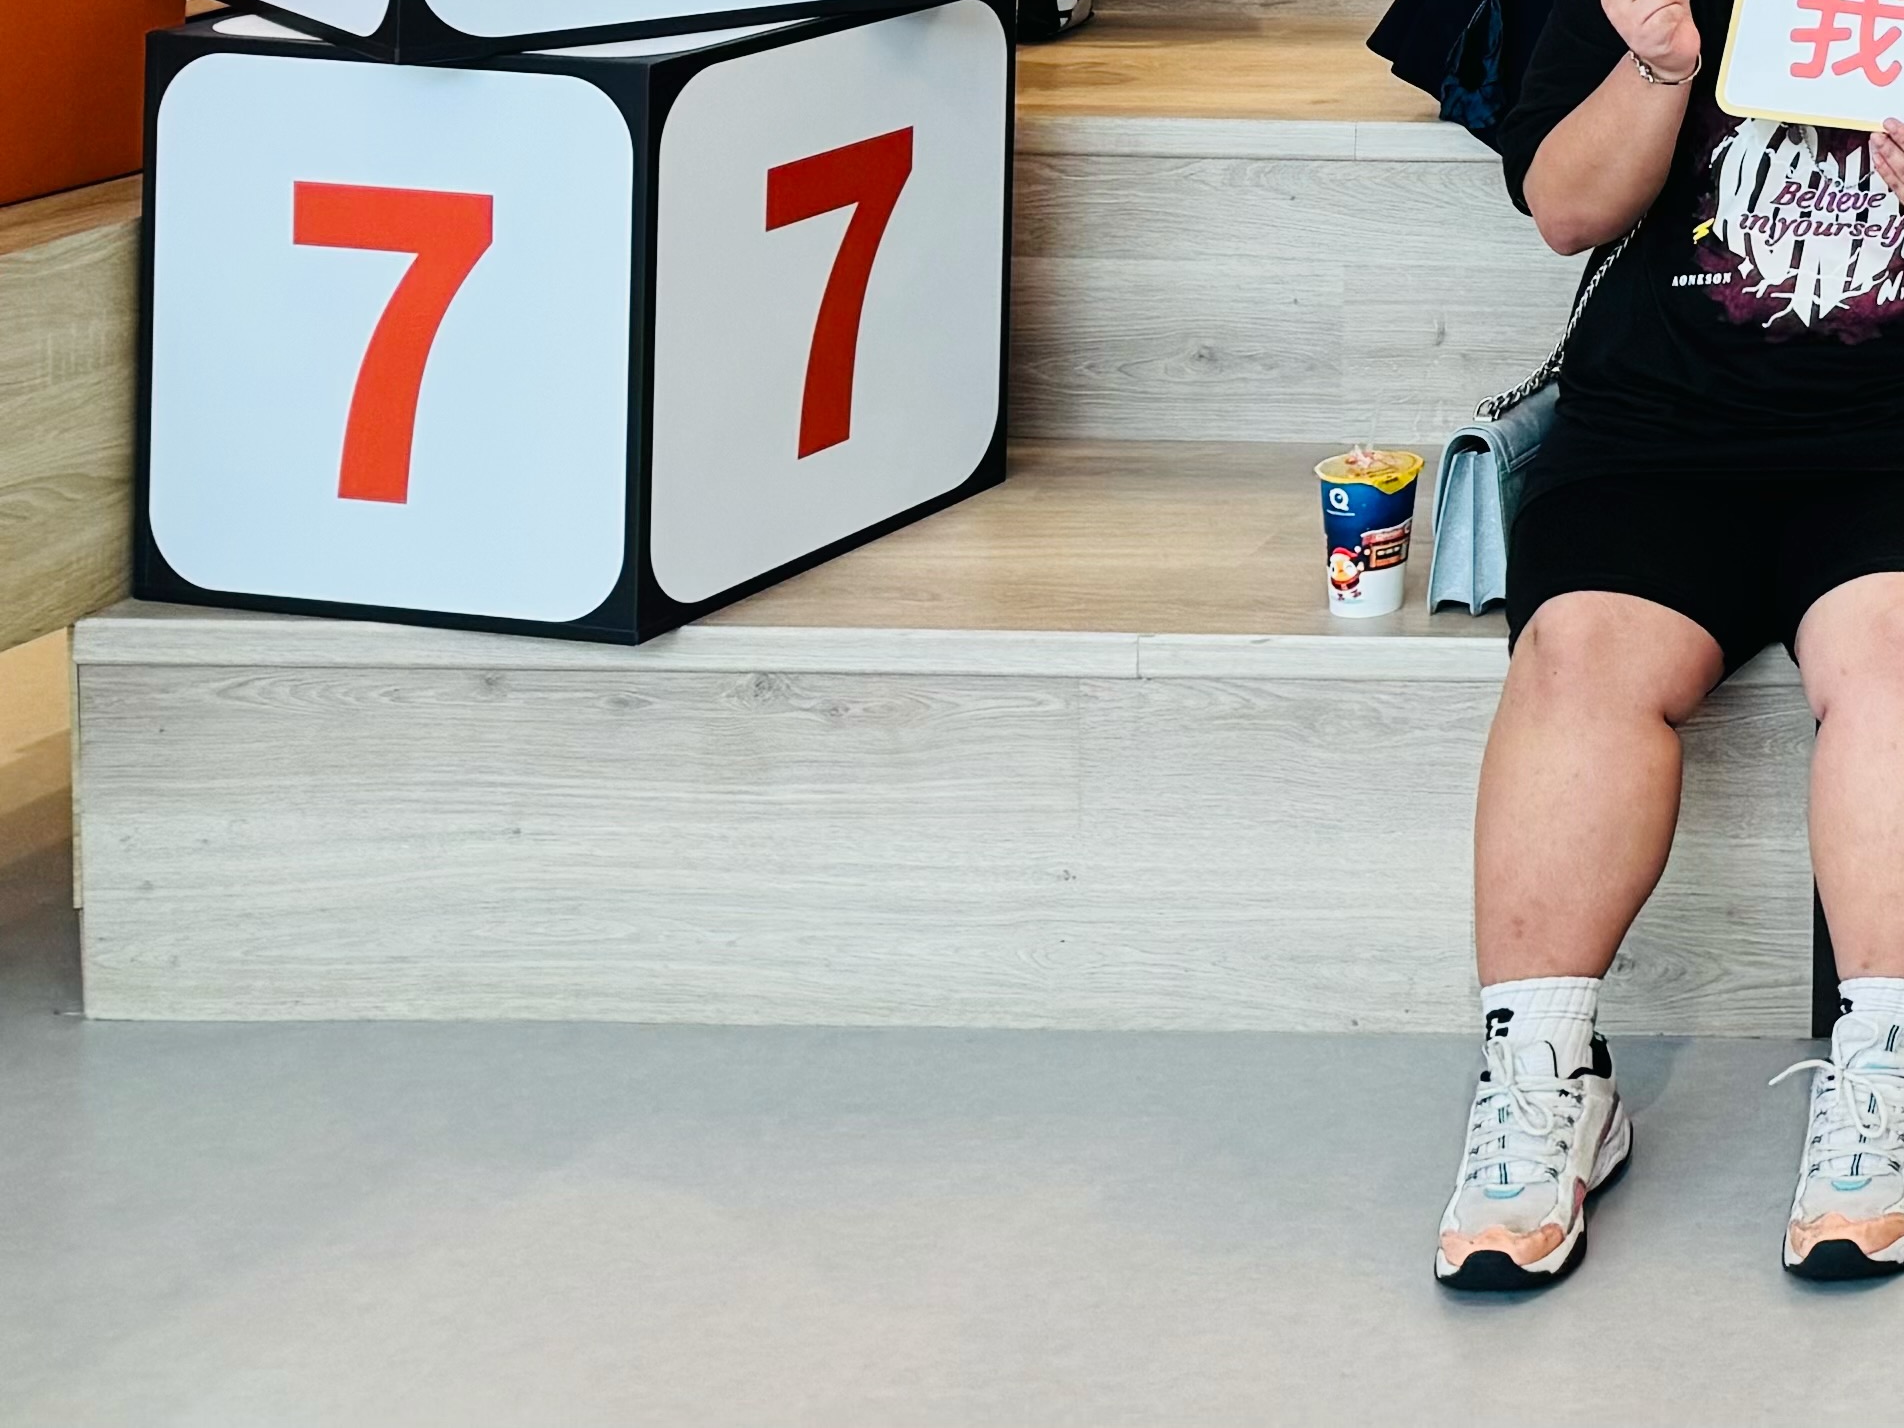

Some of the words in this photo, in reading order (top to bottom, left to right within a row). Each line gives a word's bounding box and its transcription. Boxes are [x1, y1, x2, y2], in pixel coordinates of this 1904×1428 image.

[1739, 211, 1769, 234] in
[1769, 178, 1887, 213] Believe
[293, 180, 495, 506] 7
[765, 126, 916, 461] 7
